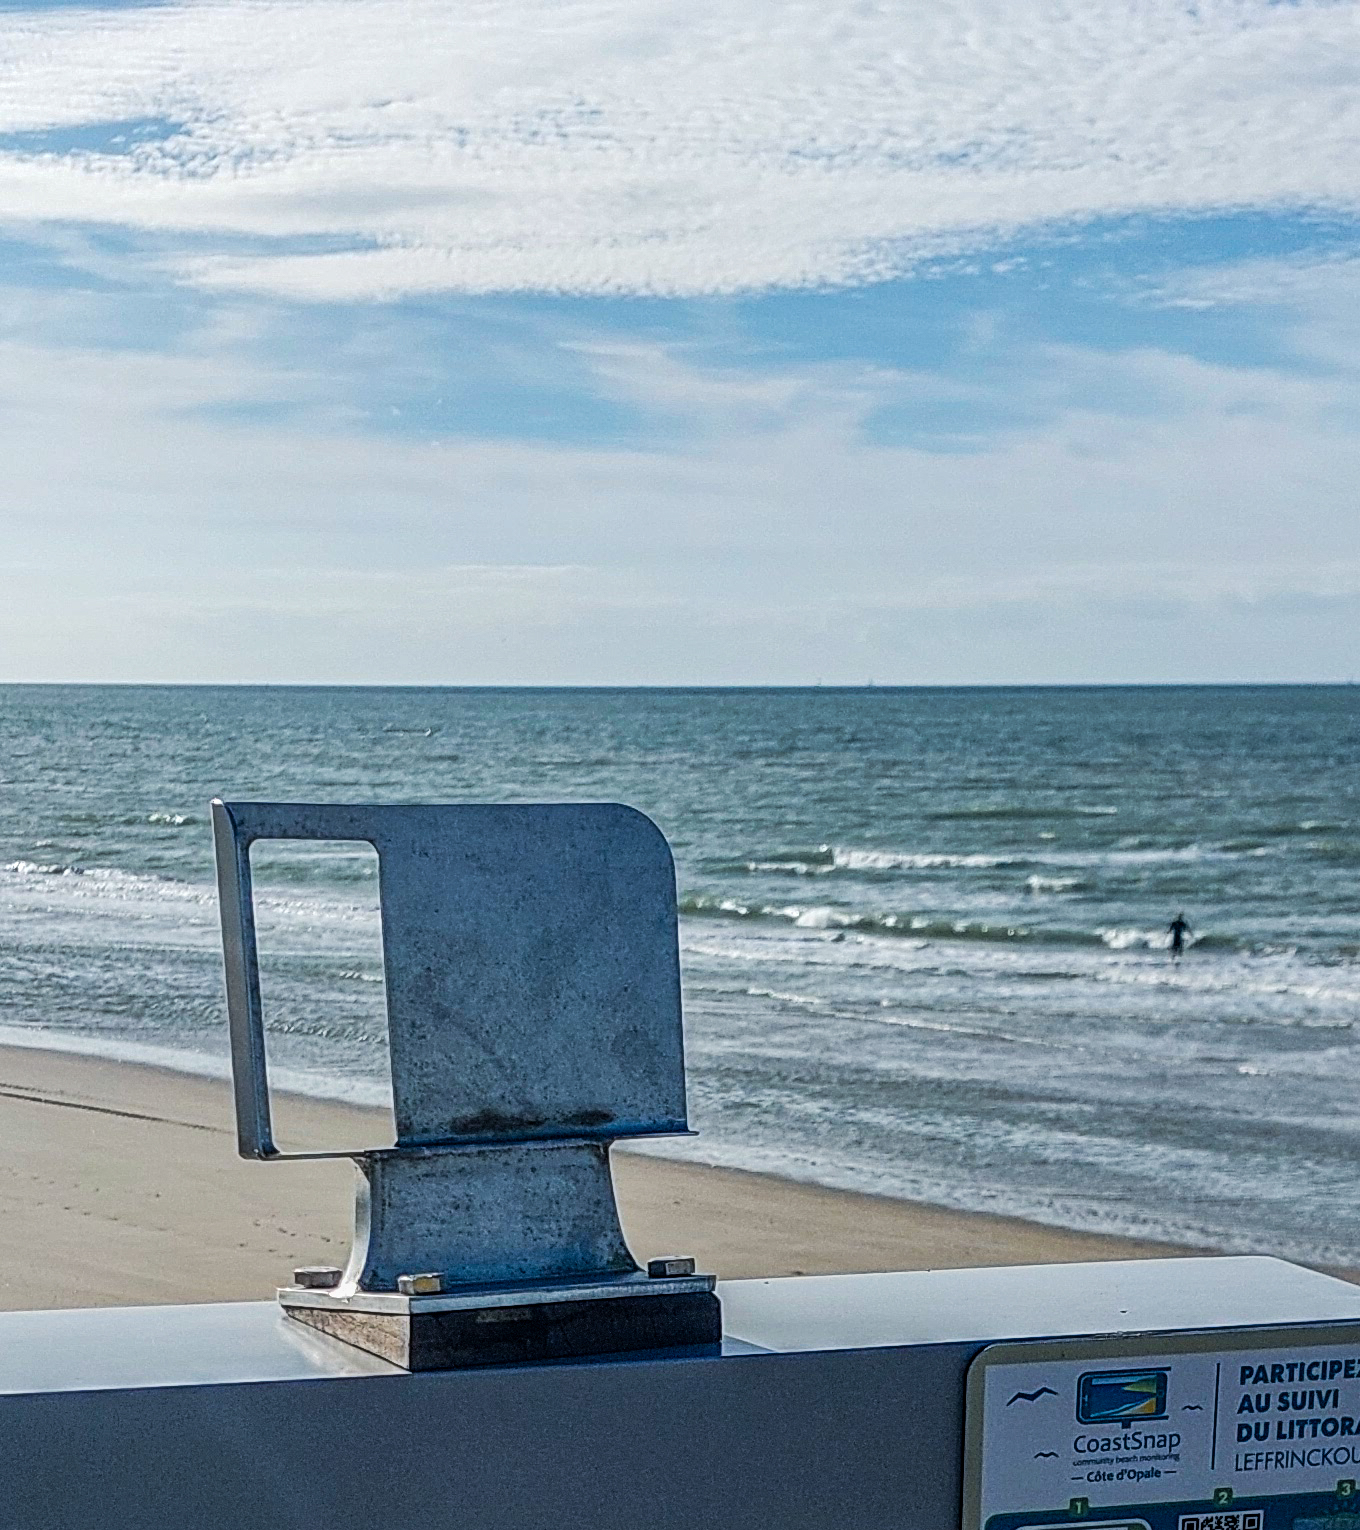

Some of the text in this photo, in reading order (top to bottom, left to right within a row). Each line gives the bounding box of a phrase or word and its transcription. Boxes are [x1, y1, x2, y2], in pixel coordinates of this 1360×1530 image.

[1237, 1389, 1339, 1414] AU SUIVI
[1237, 1421, 1270, 1442] DU
[1073, 1431, 1180, 1453] CoastSnap
[1073, 1453, 1180, 1466] community beach monitoring
[1087, 1467, 1161, 1482] Côte d'Opale
[1341, 1483, 1351, 1496] 3
[1218, 1492, 1228, 1504] 2
[1075, 1502, 1082, 1514] 1
